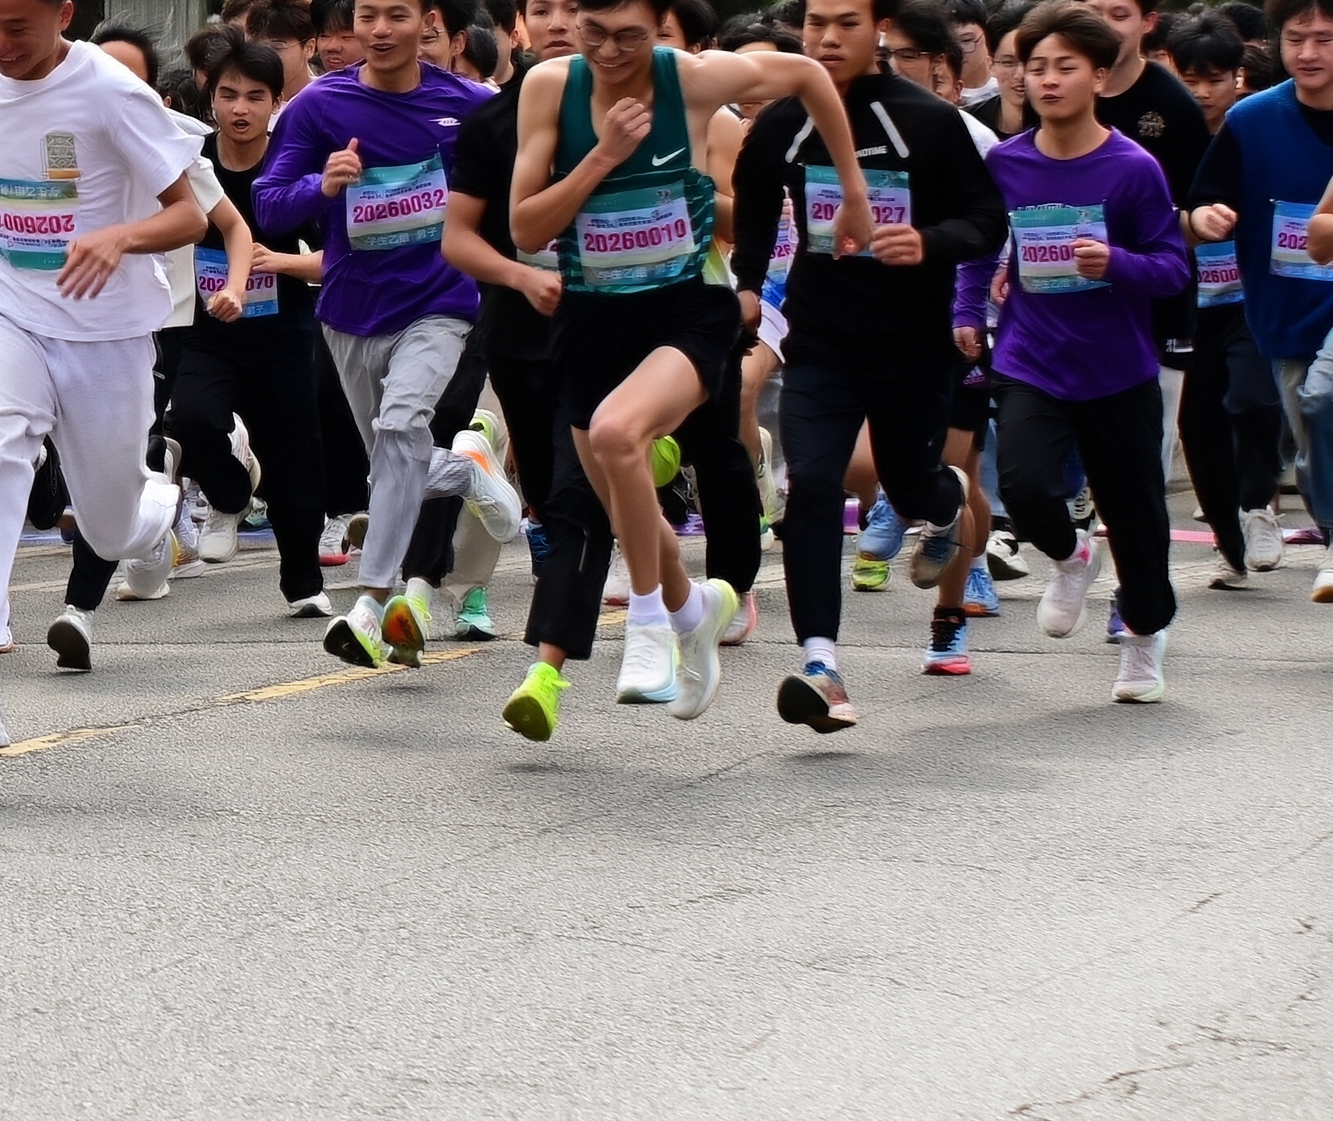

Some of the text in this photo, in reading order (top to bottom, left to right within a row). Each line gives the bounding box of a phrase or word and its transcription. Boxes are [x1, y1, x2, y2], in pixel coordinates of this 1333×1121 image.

[353, 188, 447, 224] 20260032
[811, 202, 906, 224] 20027
[583, 218, 687, 253] 20260010
[1020, 243, 1075, 263] 20260
[198, 275, 274, 293] 202070
